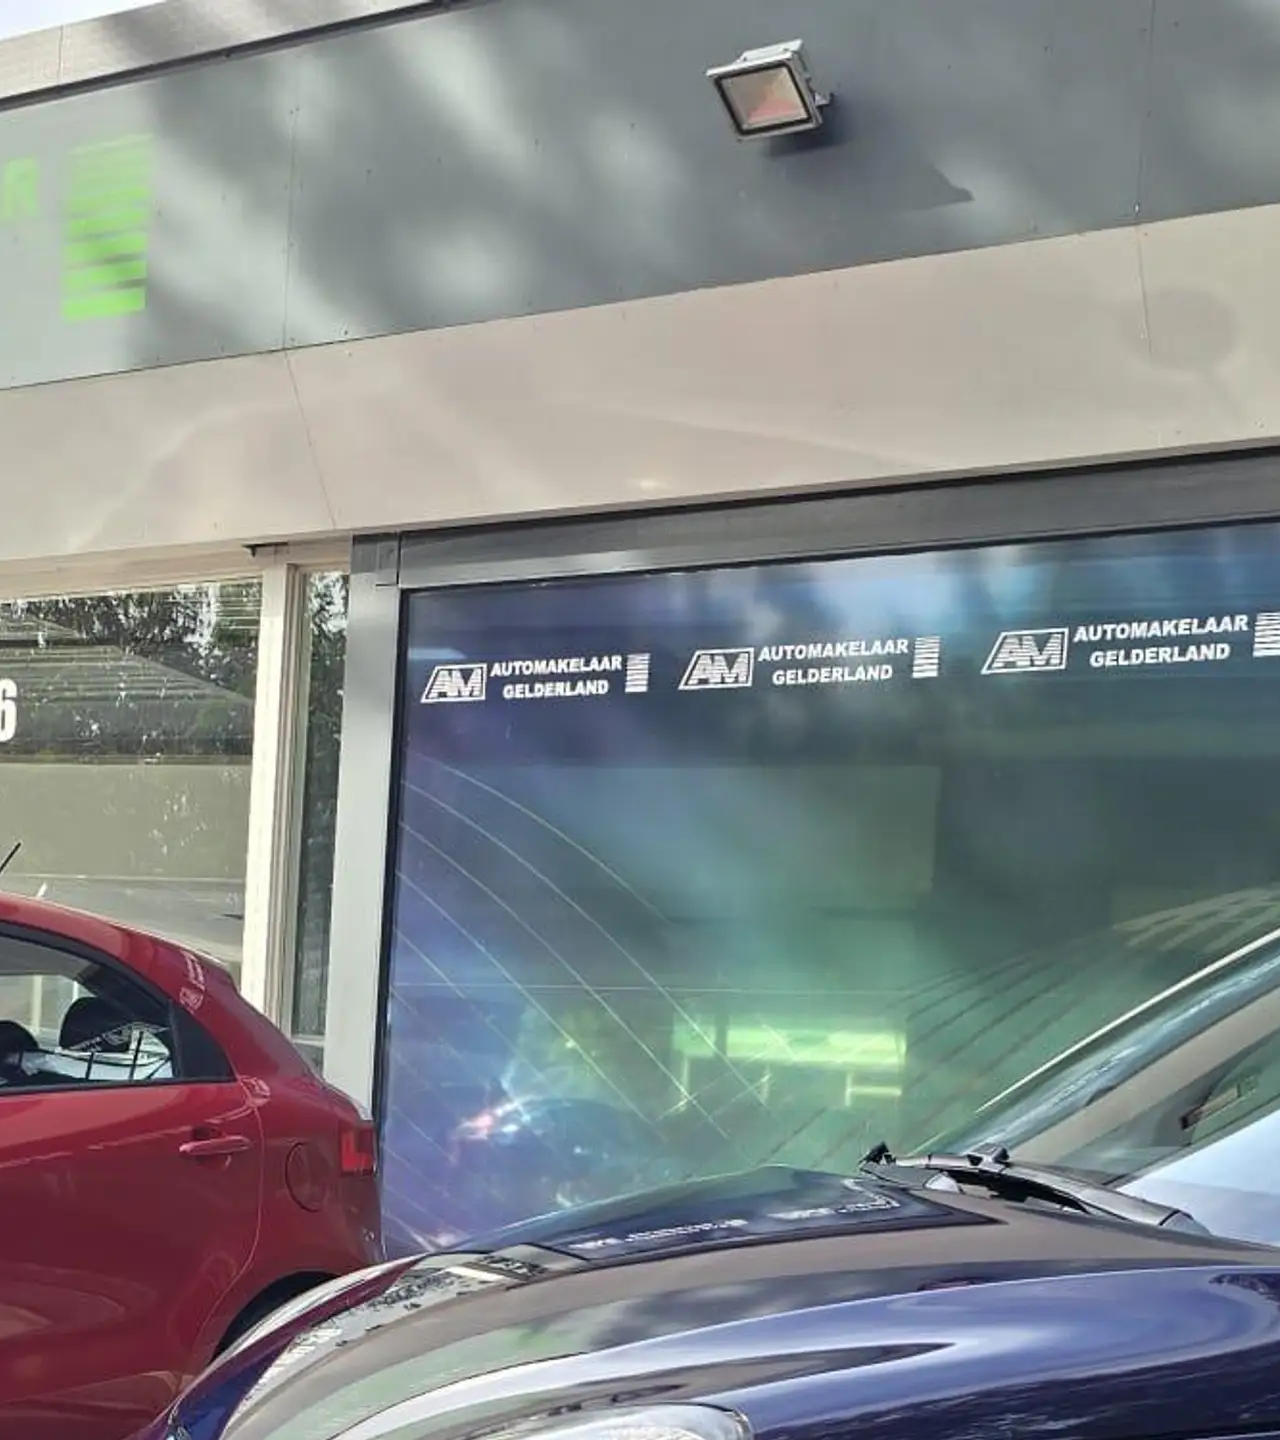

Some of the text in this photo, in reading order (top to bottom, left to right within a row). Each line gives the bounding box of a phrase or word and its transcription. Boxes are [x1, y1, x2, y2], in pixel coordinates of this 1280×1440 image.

[1073, 614, 1249, 644] AUTOMAKELAAR
[758, 638, 909, 662] AUTOMAKELAAR
[1089, 643, 1231, 669] GELDERLAND
[490, 654, 622, 677] AUTOMAKELAAR
[771, 665, 893, 686] GELDERLAND
[503, 678, 609, 699] GELDERLAND
